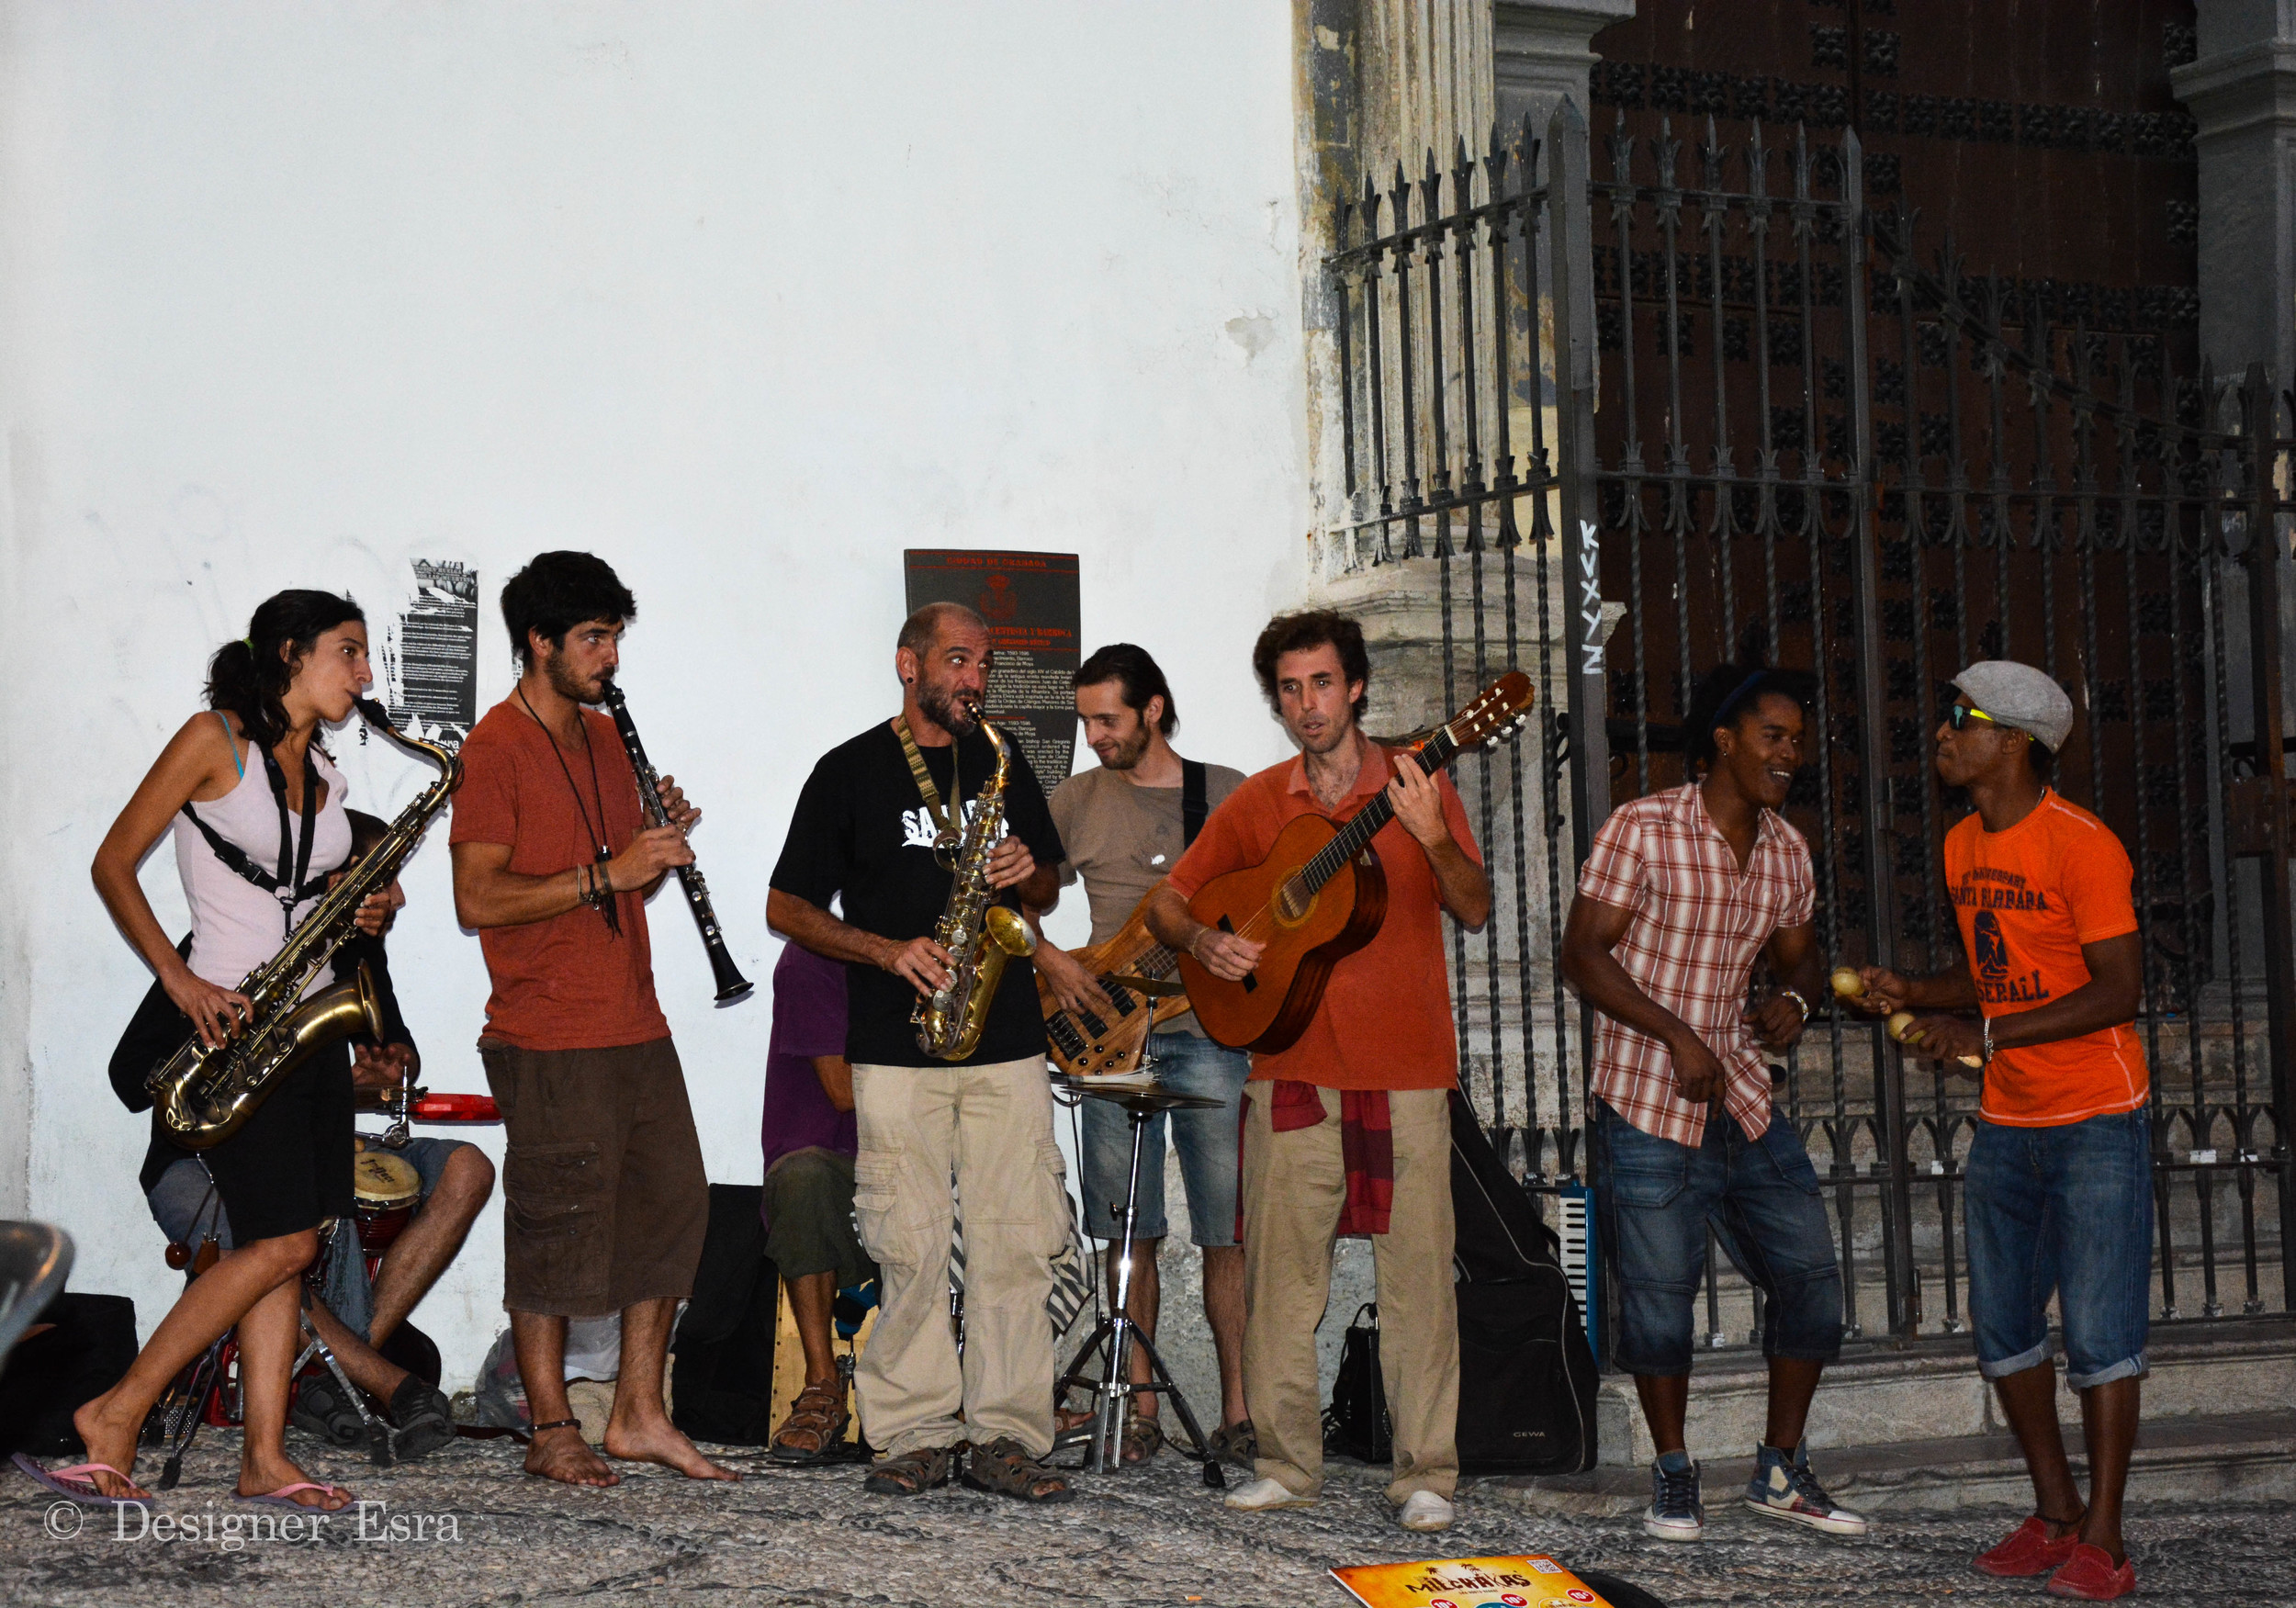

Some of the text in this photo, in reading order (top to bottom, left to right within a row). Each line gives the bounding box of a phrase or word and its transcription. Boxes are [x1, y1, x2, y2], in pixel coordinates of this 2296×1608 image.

[947, 557, 1047, 568] CIUDAD DE GRANADA
[989, 626, 1073, 637] CENTISTA Y BARROCA
[1976, 969, 2050, 1003] SEBALL
